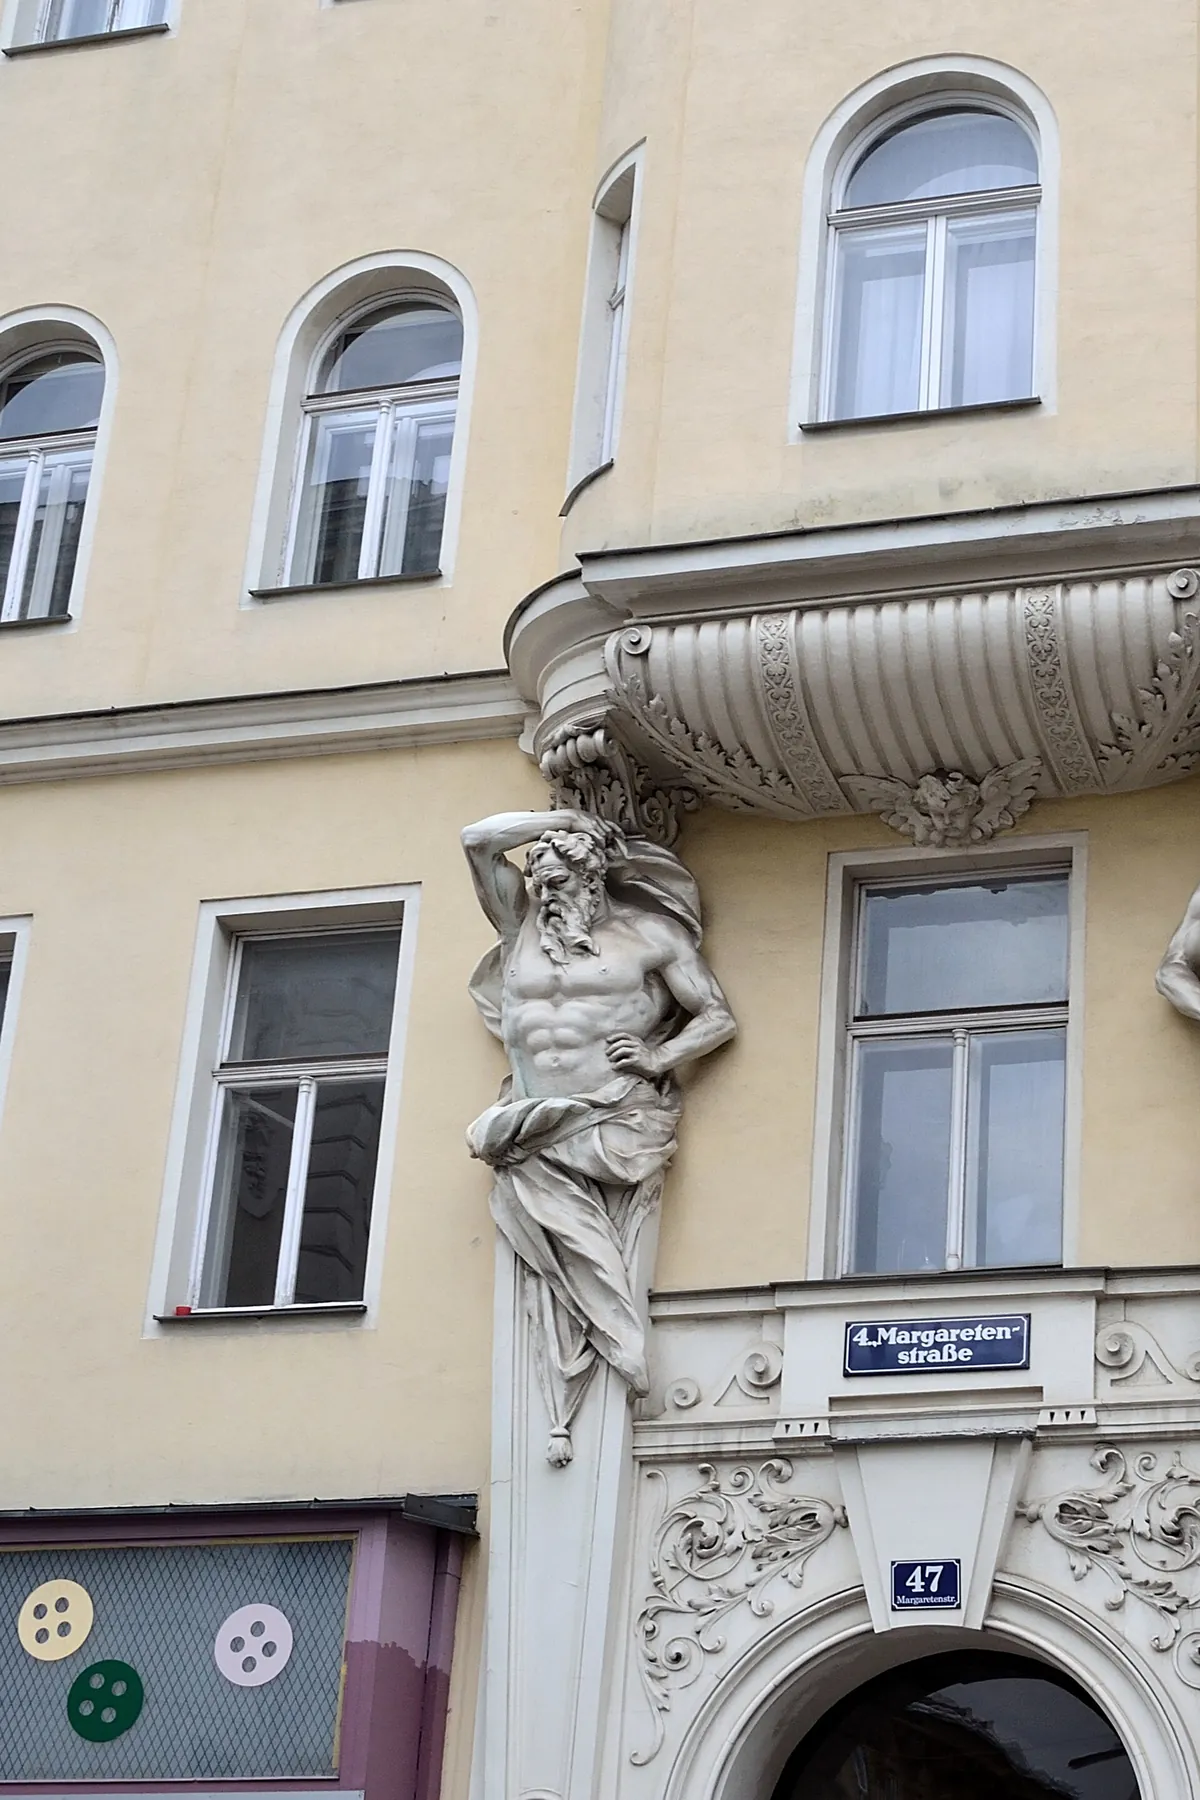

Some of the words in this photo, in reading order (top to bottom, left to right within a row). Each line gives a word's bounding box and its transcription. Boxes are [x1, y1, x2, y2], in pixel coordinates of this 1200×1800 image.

[877, 1324, 1021, 1348] Margareten-
[897, 1344, 973, 1365] straße
[905, 1565, 944, 1593] 47
[896, 1595, 957, 1605] Margaretenstr.
